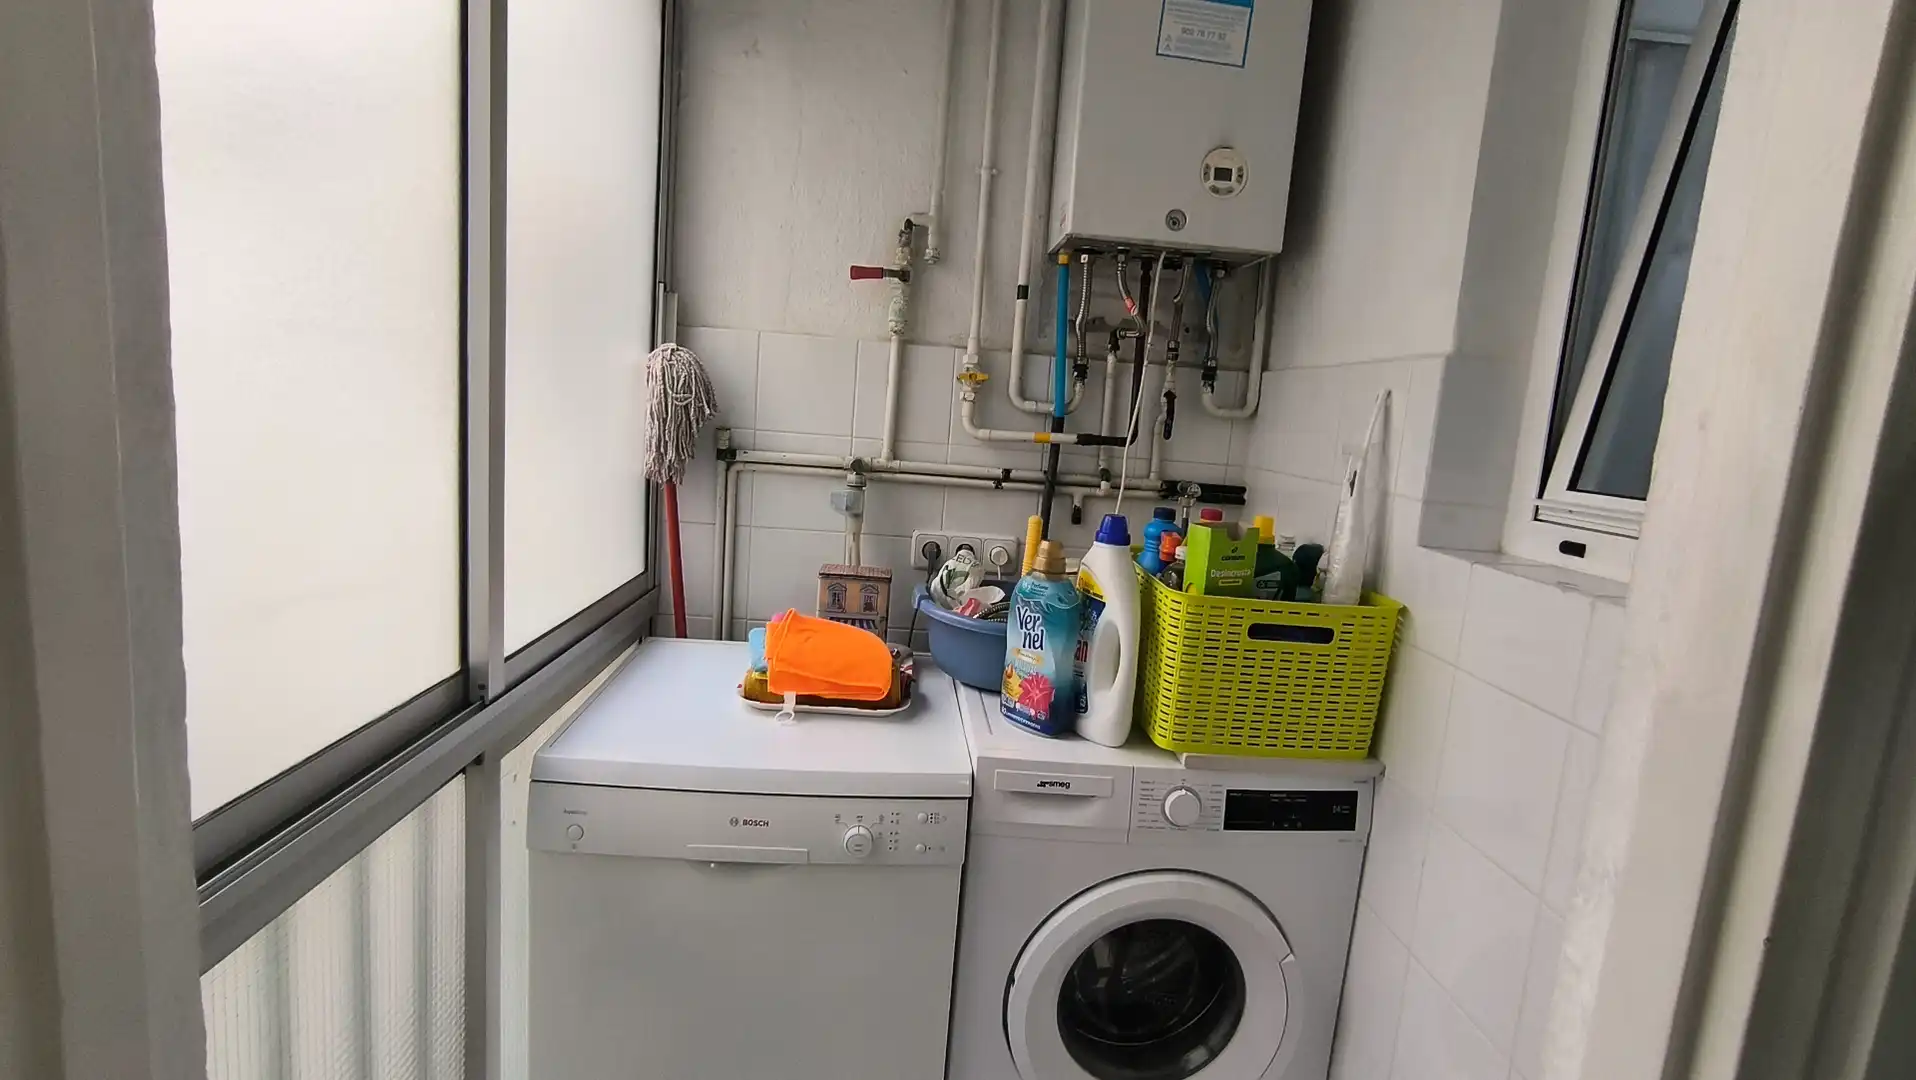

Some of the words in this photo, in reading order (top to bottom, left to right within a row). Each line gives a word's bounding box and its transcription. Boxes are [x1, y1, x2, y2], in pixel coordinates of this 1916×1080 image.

[1017, 606, 1041, 632] Ver
[1022, 628, 1044, 651] nel
[1074, 640, 1088, 662] an
[1049, 781, 1071, 790] smeg
[742, 819, 769, 827] BOSCH
